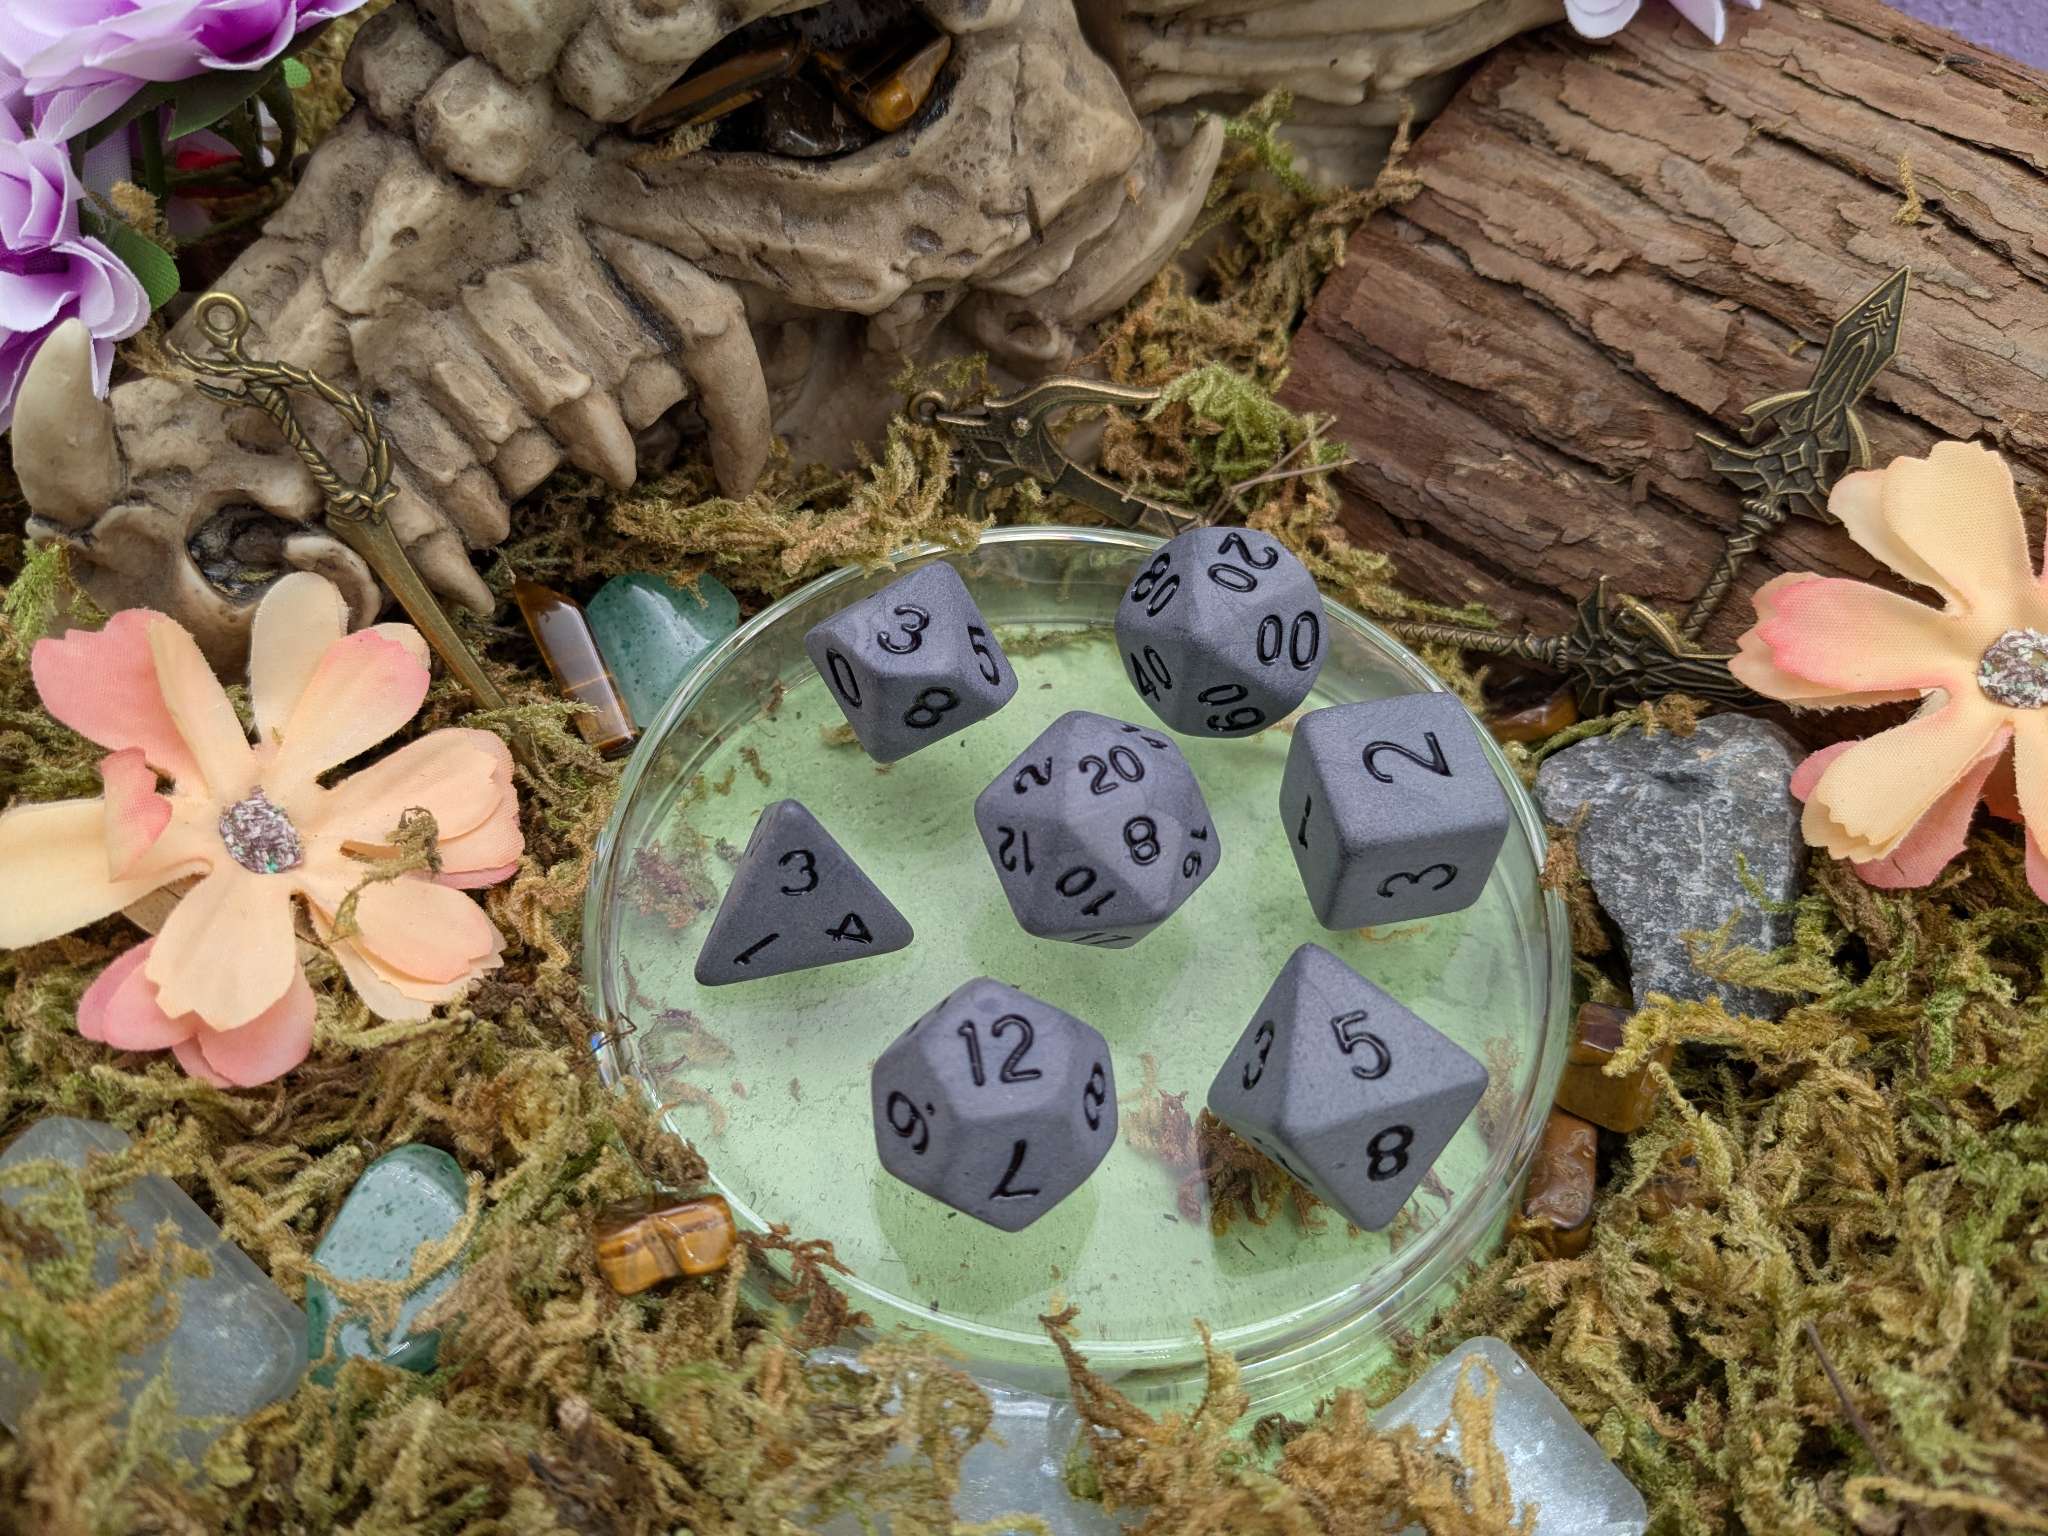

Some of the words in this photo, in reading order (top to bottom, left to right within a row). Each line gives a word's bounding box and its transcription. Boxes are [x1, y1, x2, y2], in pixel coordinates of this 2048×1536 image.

[1131, 552, 1180, 617] 80
[1208, 532, 1279, 592] 20
[877, 603, 930, 654] 3
[1256, 610, 1320, 671] 00
[967, 623, 1001, 686] 5
[1130, 645, 1173, 702] 40
[904, 687, 960, 729] 8
[1013, 756, 1053, 794] 2
[1078, 745, 1145, 795] 20
[1362, 732, 1453, 783] 2
[1123, 816, 1161, 866] 8
[778, 849, 819, 896] 3
[1056, 866, 1117, 916] 10
[1377, 863, 1458, 898] 3
[733, 933, 780, 965] 1
[825, 912, 873, 944] 4
[958, 1013, 1042, 1087] 12
[1242, 1020, 1275, 1090] 3
[1331, 1010, 1392, 1080] 5
[988, 1139, 1040, 1199] 7
[1366, 1124, 1415, 1182] 8
